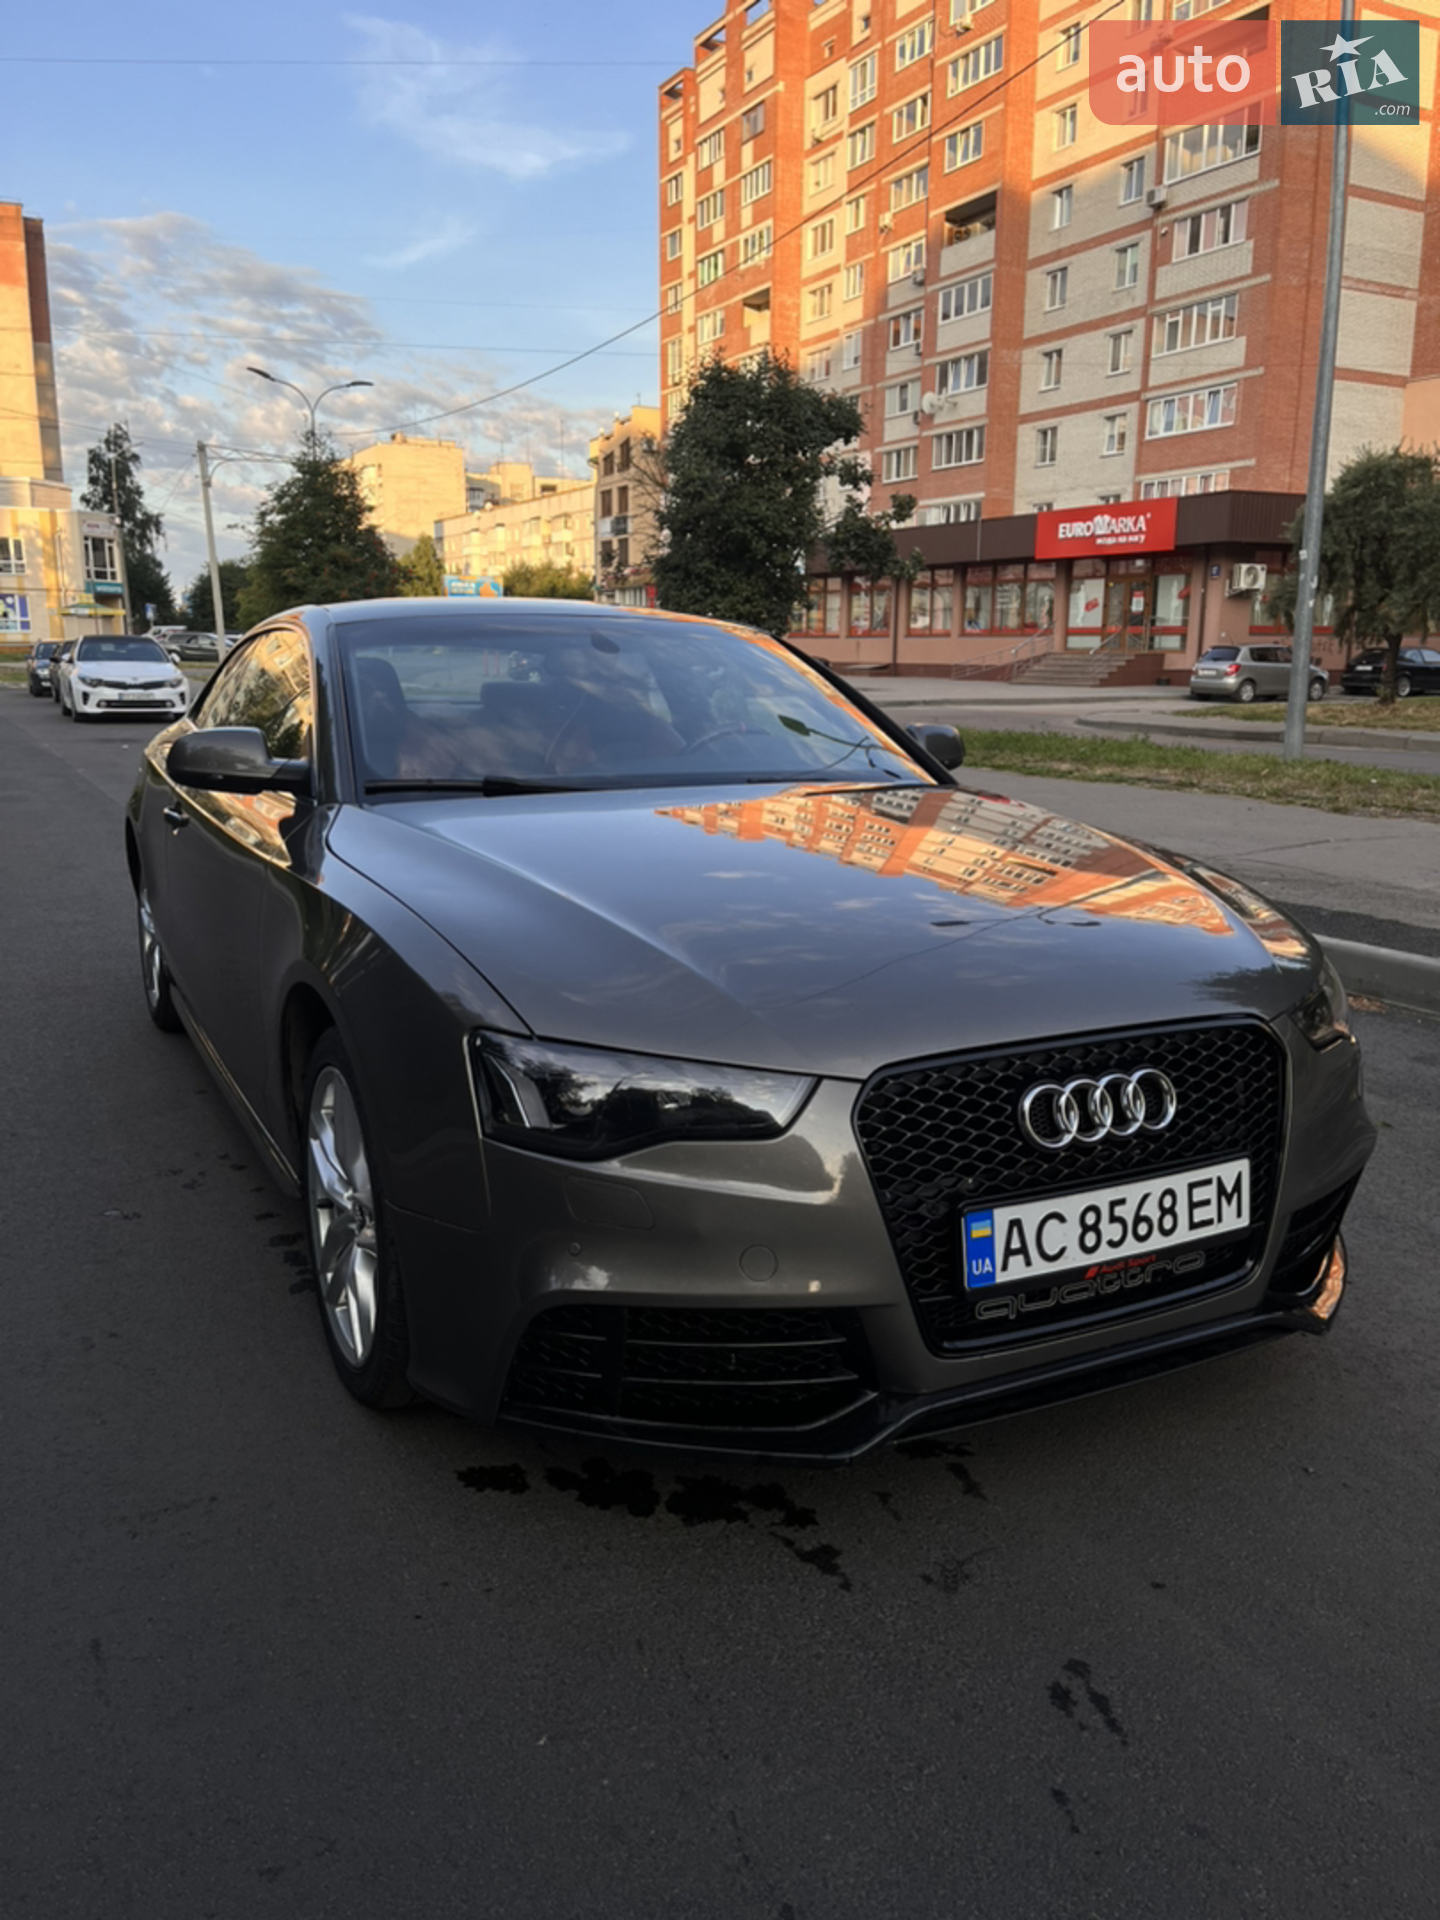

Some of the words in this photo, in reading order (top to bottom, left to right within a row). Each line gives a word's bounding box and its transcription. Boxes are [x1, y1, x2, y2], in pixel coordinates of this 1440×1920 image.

[1001, 1211, 1067, 1272] AC
[1078, 1187, 1178, 1254] 8568
[1187, 1170, 1242, 1231] EM
[971, 1257, 993, 1276] UA
[976, 1250, 1205, 1320] quattro
